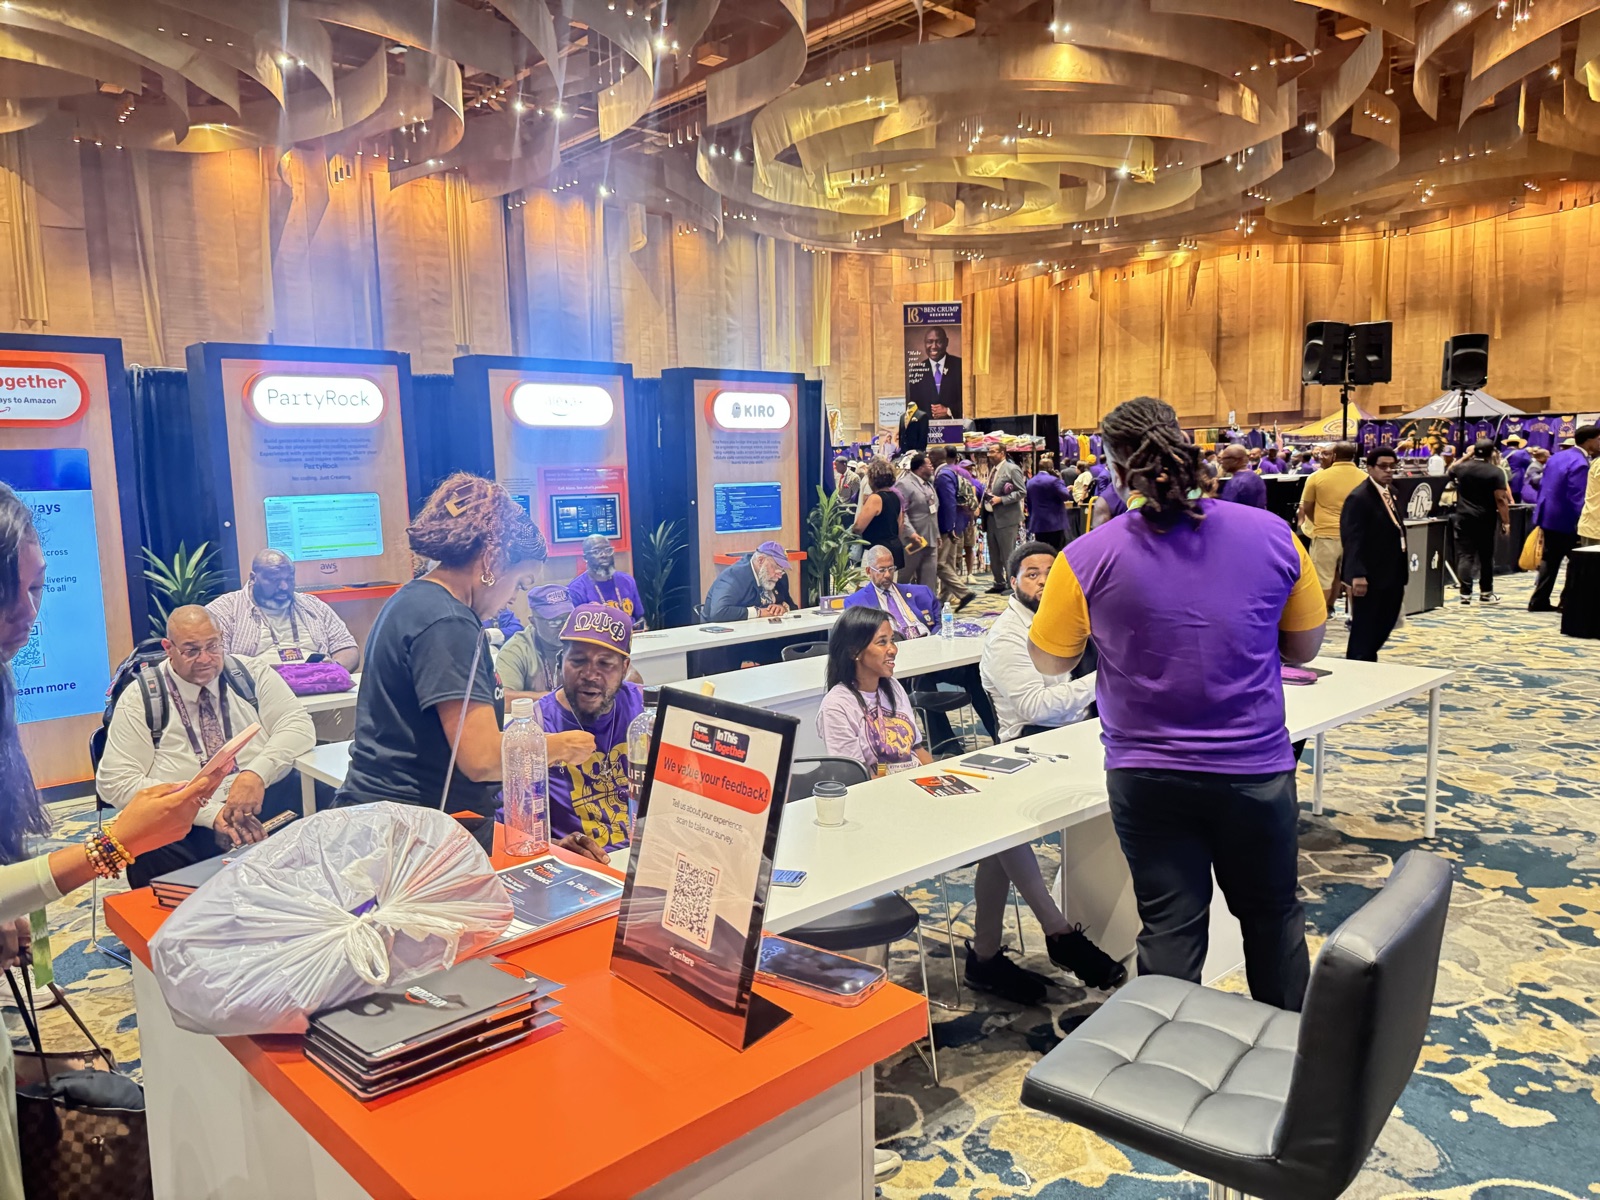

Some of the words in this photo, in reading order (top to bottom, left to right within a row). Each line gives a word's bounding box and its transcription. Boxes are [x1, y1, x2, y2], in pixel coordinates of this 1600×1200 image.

[267, 389, 370, 410] PartyRock
[744, 405, 774, 417] KIRO
[320, 562, 338, 570] aws
[17, 684, 44, 696] earn
[46, 681, 76, 694] more
[717, 729, 723, 740] In
[723, 731, 738, 744] This
[715, 740, 745, 758] Together
[664, 756, 676, 772] We
[677, 763, 699, 779] value
[700, 770, 720, 786] your
[721, 776, 768, 802] feedback!
[687, 804, 701, 816] about
[701, 811, 713, 821] your
[713, 815, 743, 832] experience,
[676, 817, 688, 826] scan
[694, 822, 705, 833] take
[705, 828, 714, 836] our
[715, 831, 734, 845] survey.
[574, 882, 588, 892] This
[669, 947, 682, 960] Scan
[682, 953, 694, 967] here
[406, 985, 448, 1008] amazon
